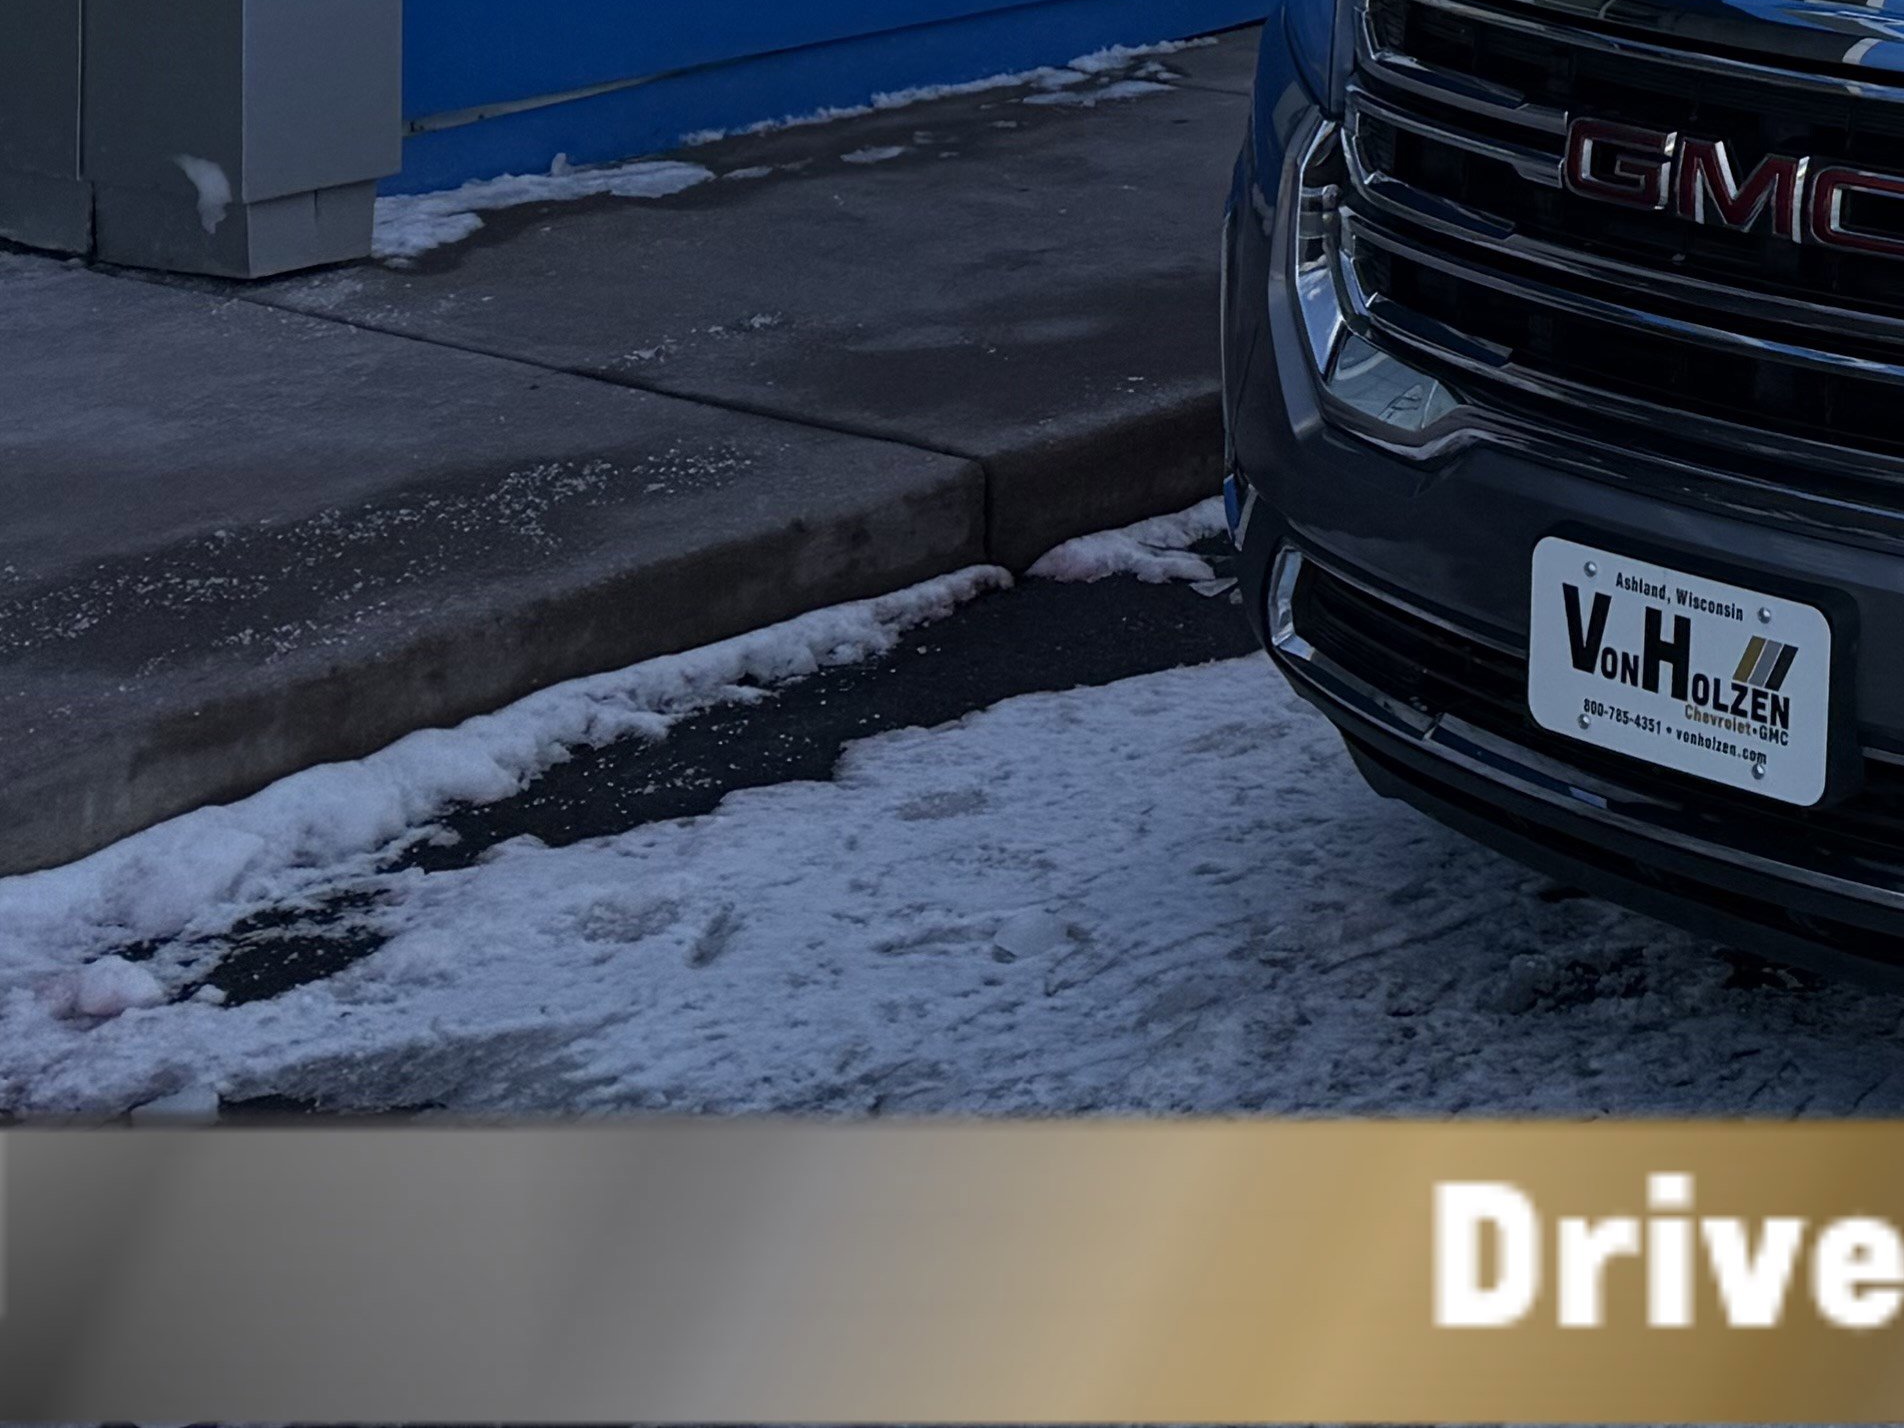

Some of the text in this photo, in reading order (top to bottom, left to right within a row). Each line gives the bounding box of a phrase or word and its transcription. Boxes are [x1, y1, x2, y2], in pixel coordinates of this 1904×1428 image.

[1615, 572, 1744, 622] Ashland, Wisconsin
[1583, 698, 1768, 766] 800-785-4351 vonholzen.com
